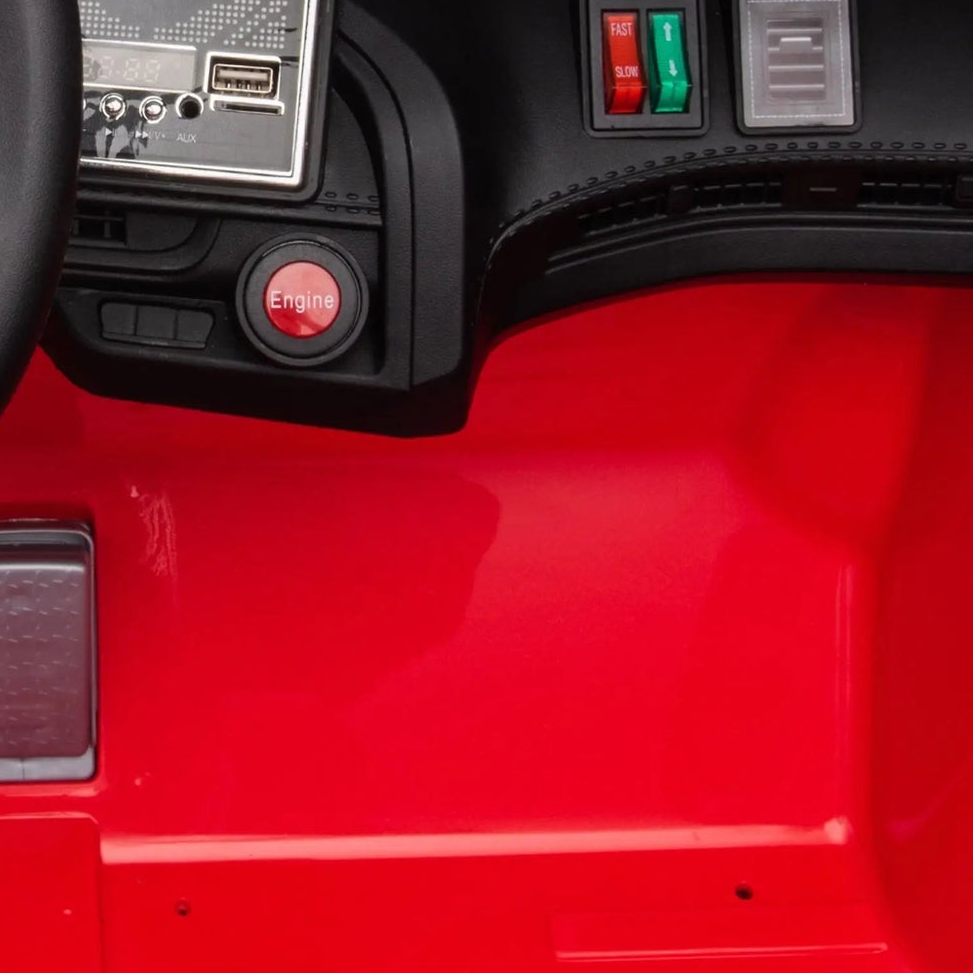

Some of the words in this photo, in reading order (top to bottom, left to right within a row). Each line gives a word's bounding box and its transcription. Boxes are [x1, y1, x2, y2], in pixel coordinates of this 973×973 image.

[610, 22, 633, 36] FAST
[615, 65, 639, 78] SLOW
[176, 132, 197, 144] AUX
[270, 290, 335, 313] Engine
